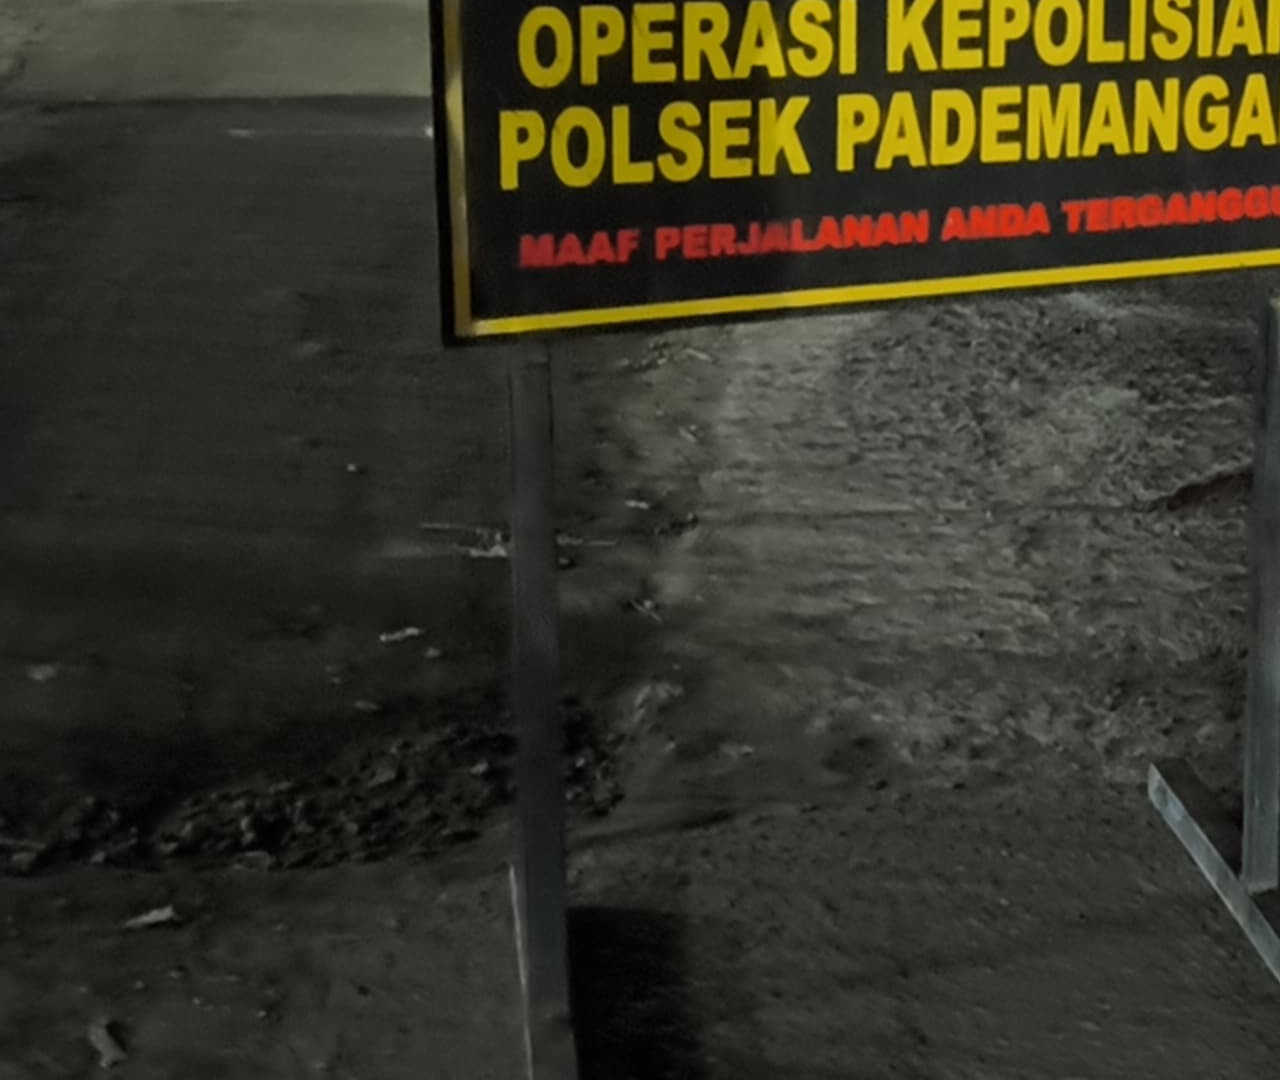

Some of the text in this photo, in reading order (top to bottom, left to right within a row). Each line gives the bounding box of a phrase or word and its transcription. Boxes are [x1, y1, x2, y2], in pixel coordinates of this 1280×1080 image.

[499, 95, 812, 191] POLSEK
[519, 229, 641, 268] MAAF
[655, 209, 931, 262] PERJALANAN
[941, 202, 1052, 242] ANDA
